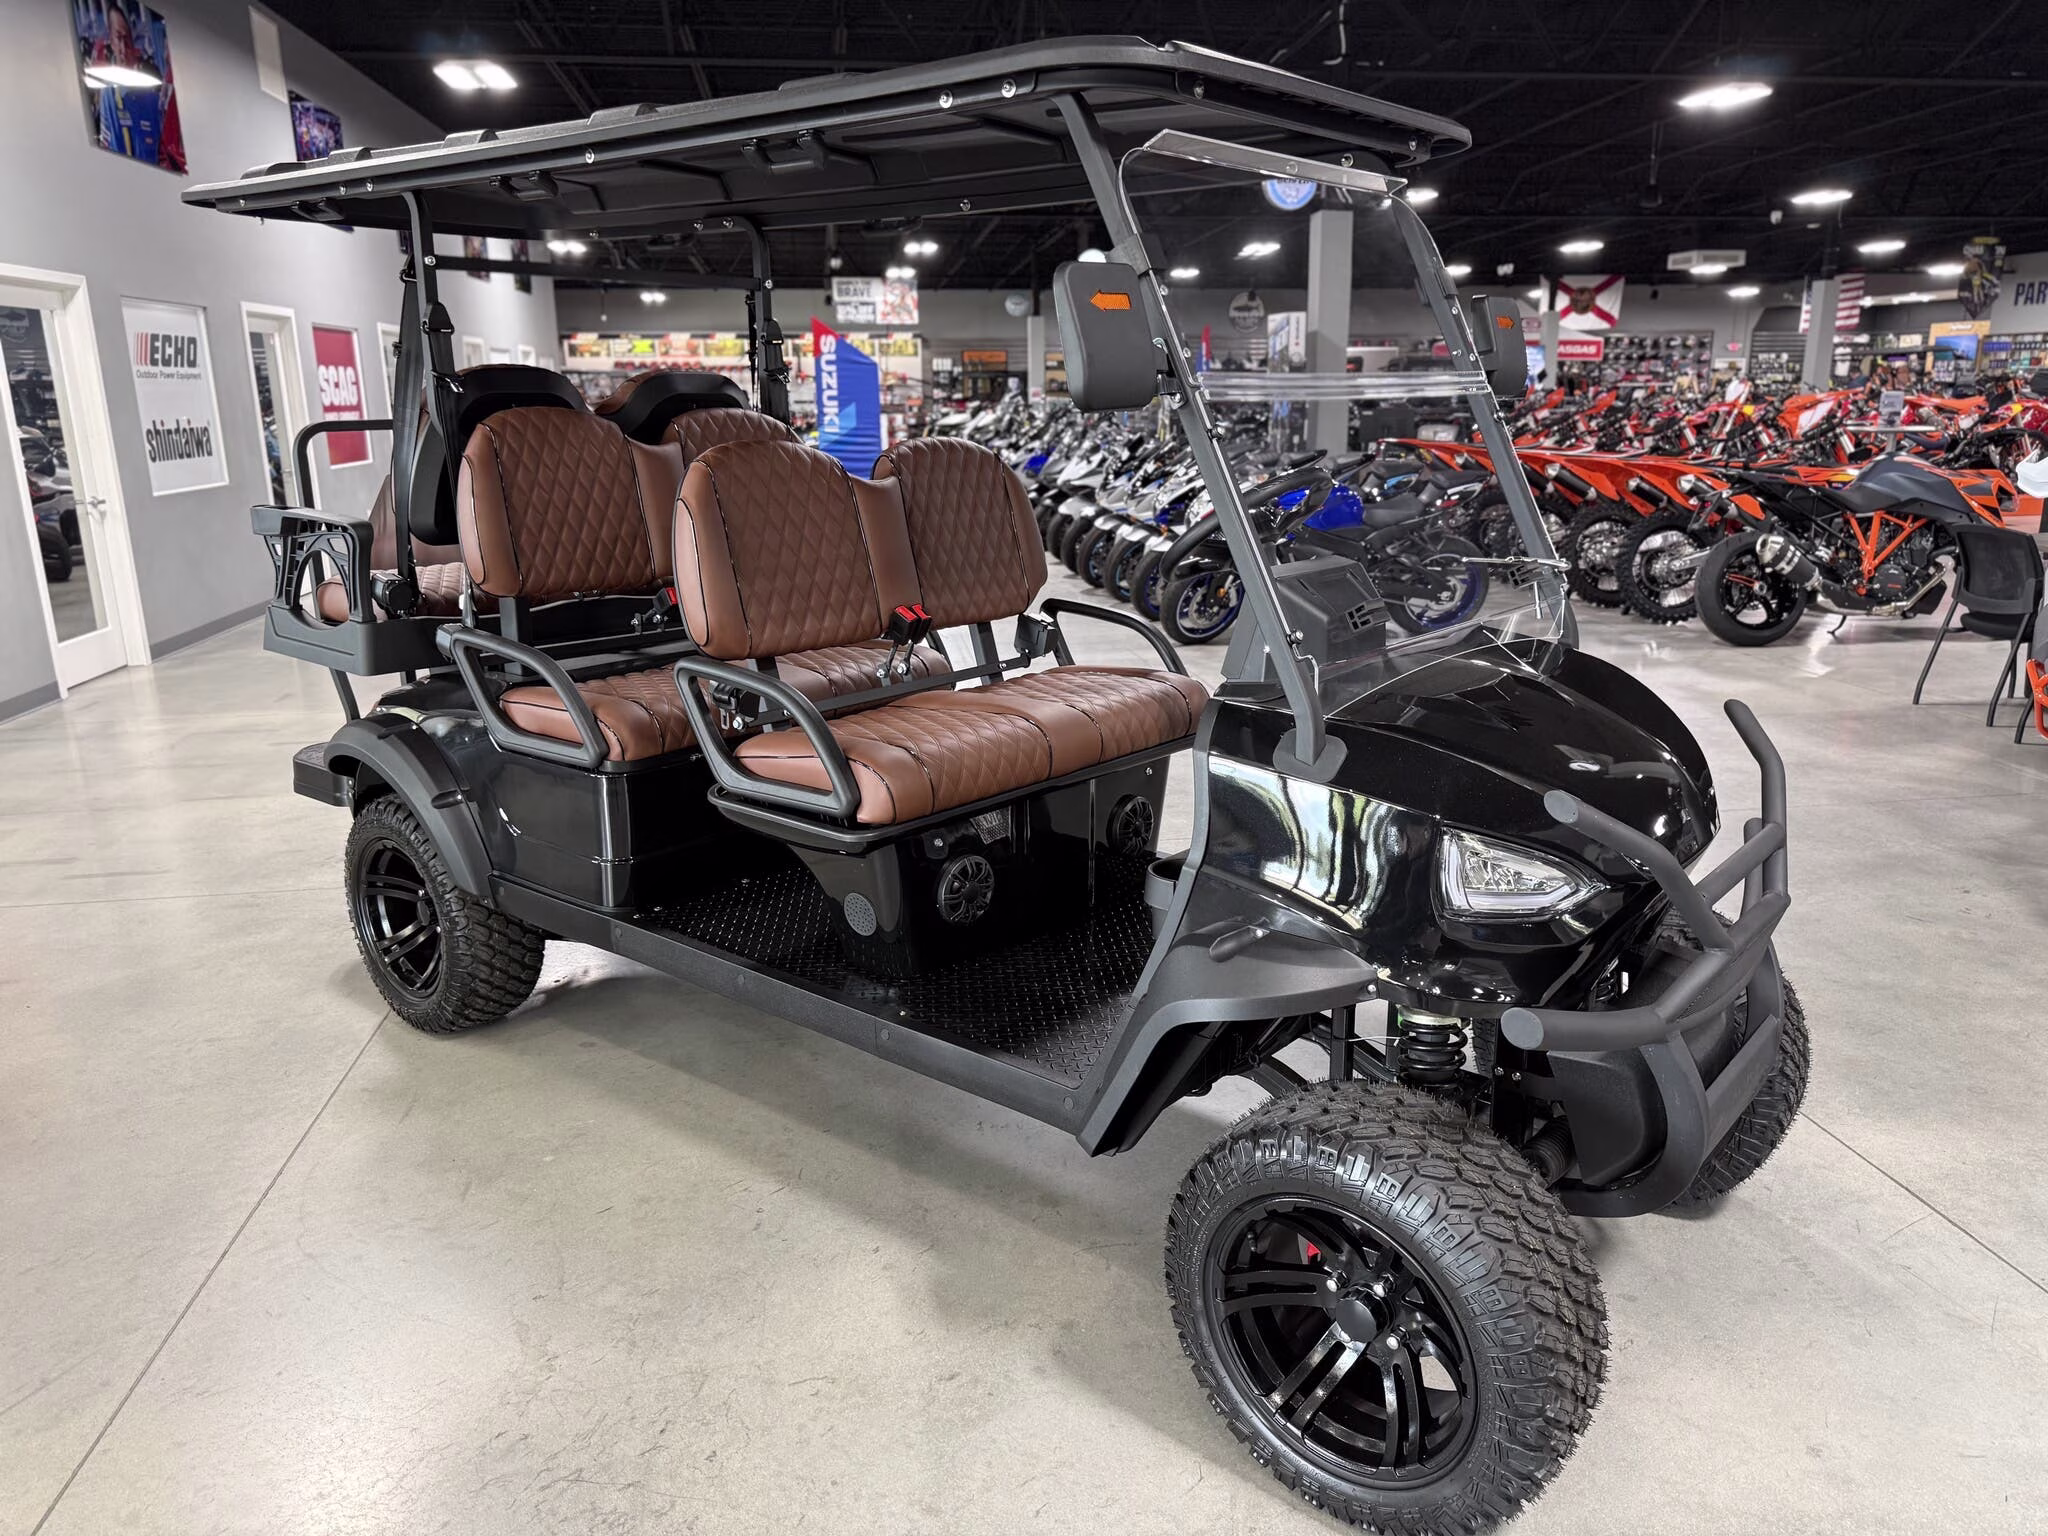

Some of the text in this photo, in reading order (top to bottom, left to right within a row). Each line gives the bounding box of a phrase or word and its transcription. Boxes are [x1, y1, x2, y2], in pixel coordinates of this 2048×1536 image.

[149, 333, 197, 368] ECHO
[1558, 344, 1597, 354] ASGAS
[318, 365, 358, 406] SCAG
[819, 333, 840, 432] SUZUKI
[146, 418, 213, 463] shindaiwa
